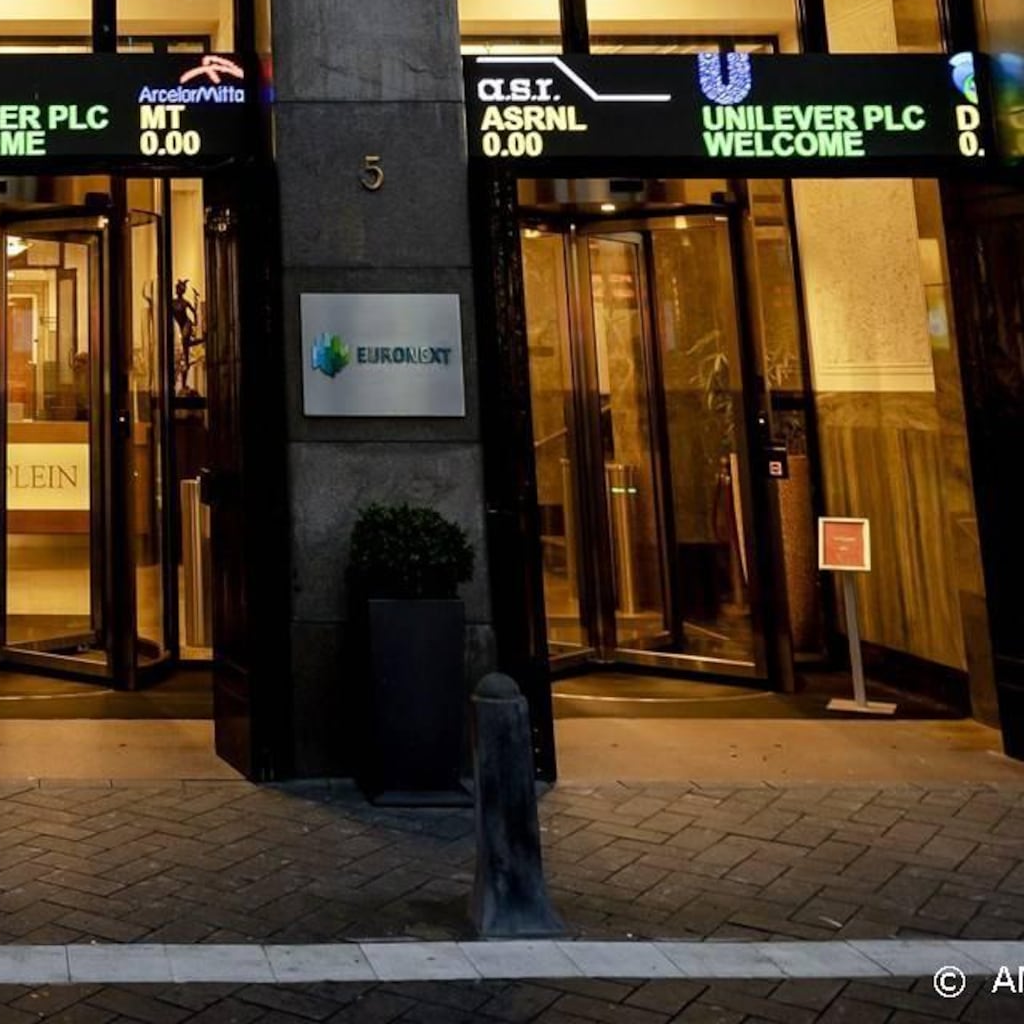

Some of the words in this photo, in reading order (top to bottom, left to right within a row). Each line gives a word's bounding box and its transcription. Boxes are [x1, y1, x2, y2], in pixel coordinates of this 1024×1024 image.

[477, 78, 561, 102] a.s.r.
[48, 105, 110, 130] PLC
[139, 104, 186, 130] MT
[480, 105, 588, 132] ASRNL
[701, 105, 859, 131] UNILEVER
[863, 105, 926, 131] PLC
[139, 130, 201, 156] 0.00
[481, 131, 544, 157] 0.00
[702, 131, 866, 157] WELCOME
[360, 154, 385, 192] 5
[355, 345, 452, 366] EURONEXT
